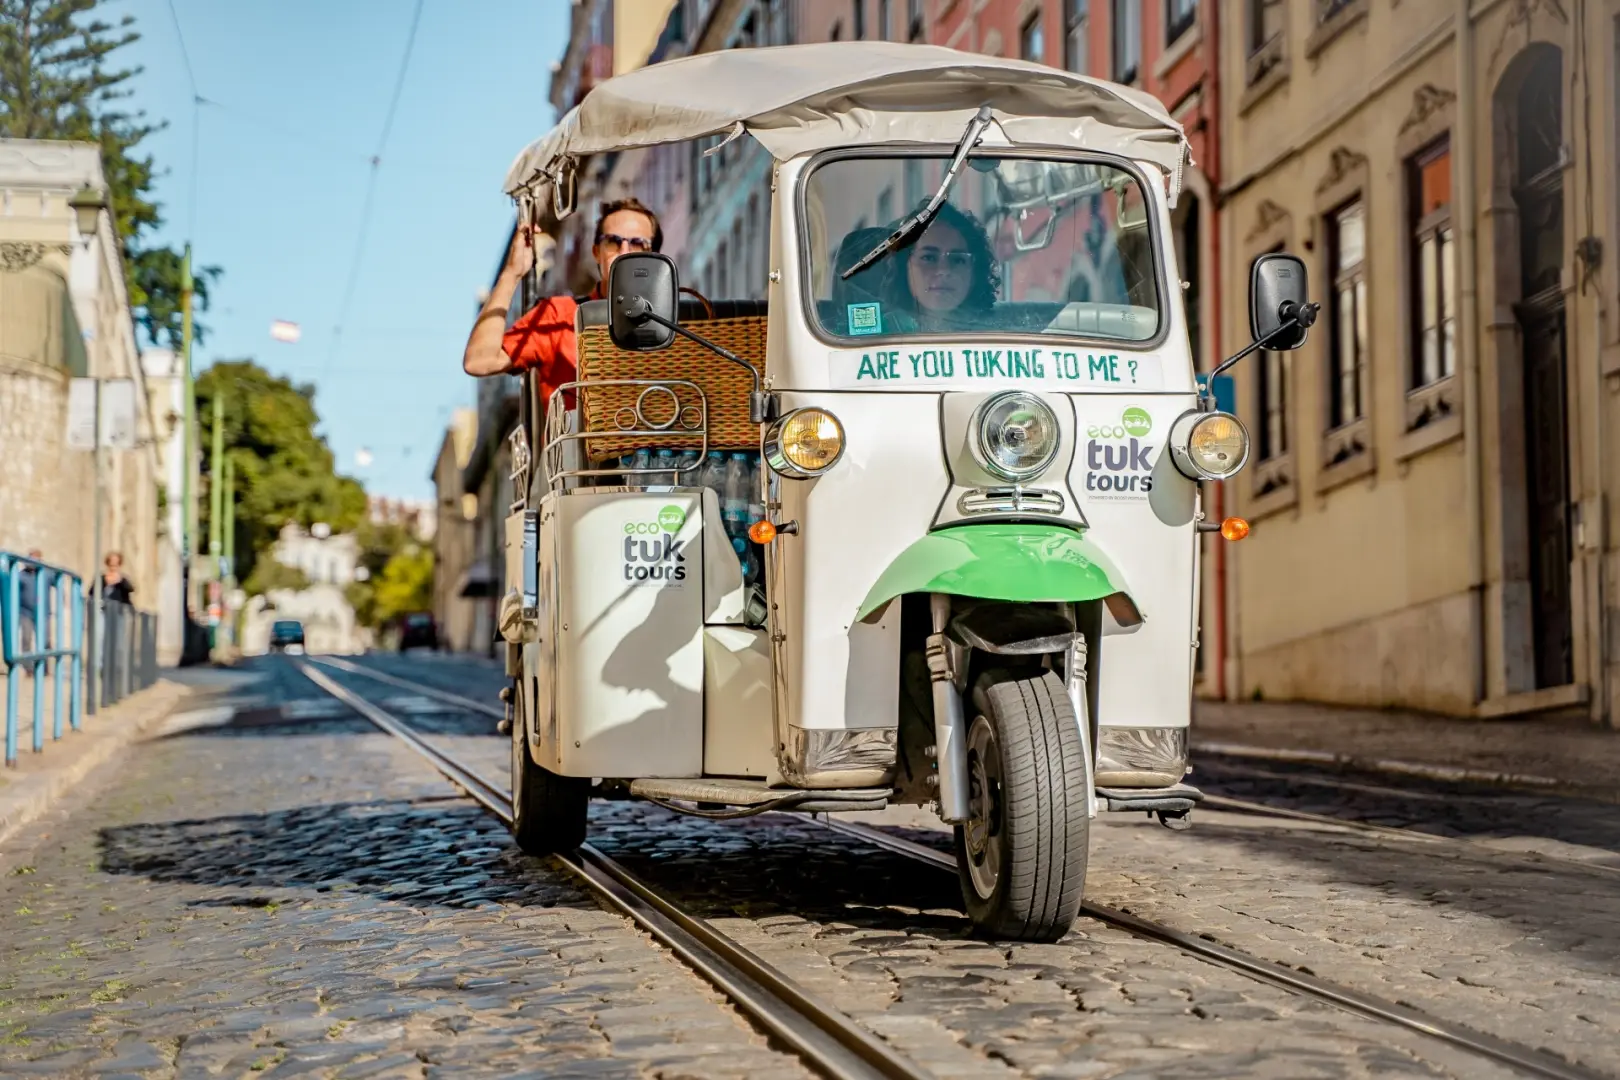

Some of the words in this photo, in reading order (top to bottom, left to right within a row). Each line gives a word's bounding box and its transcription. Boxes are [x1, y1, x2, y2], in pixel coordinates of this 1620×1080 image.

[857, 351, 900, 380] ARE
[908, 351, 955, 378] YOU
[962, 349, 1045, 377] TUKING
[1052, 351, 1080, 379] TO
[1088, 355, 1120, 382] ME
[1128, 360, 1138, 383] ?
[1087, 425, 1125, 439] eco
[1087, 438, 1154, 471] tuk
[1086, 471, 1153, 492] tours
[624, 522, 660, 535] eco
[624, 533, 686, 562] tuk
[624, 563, 686, 580] tours
